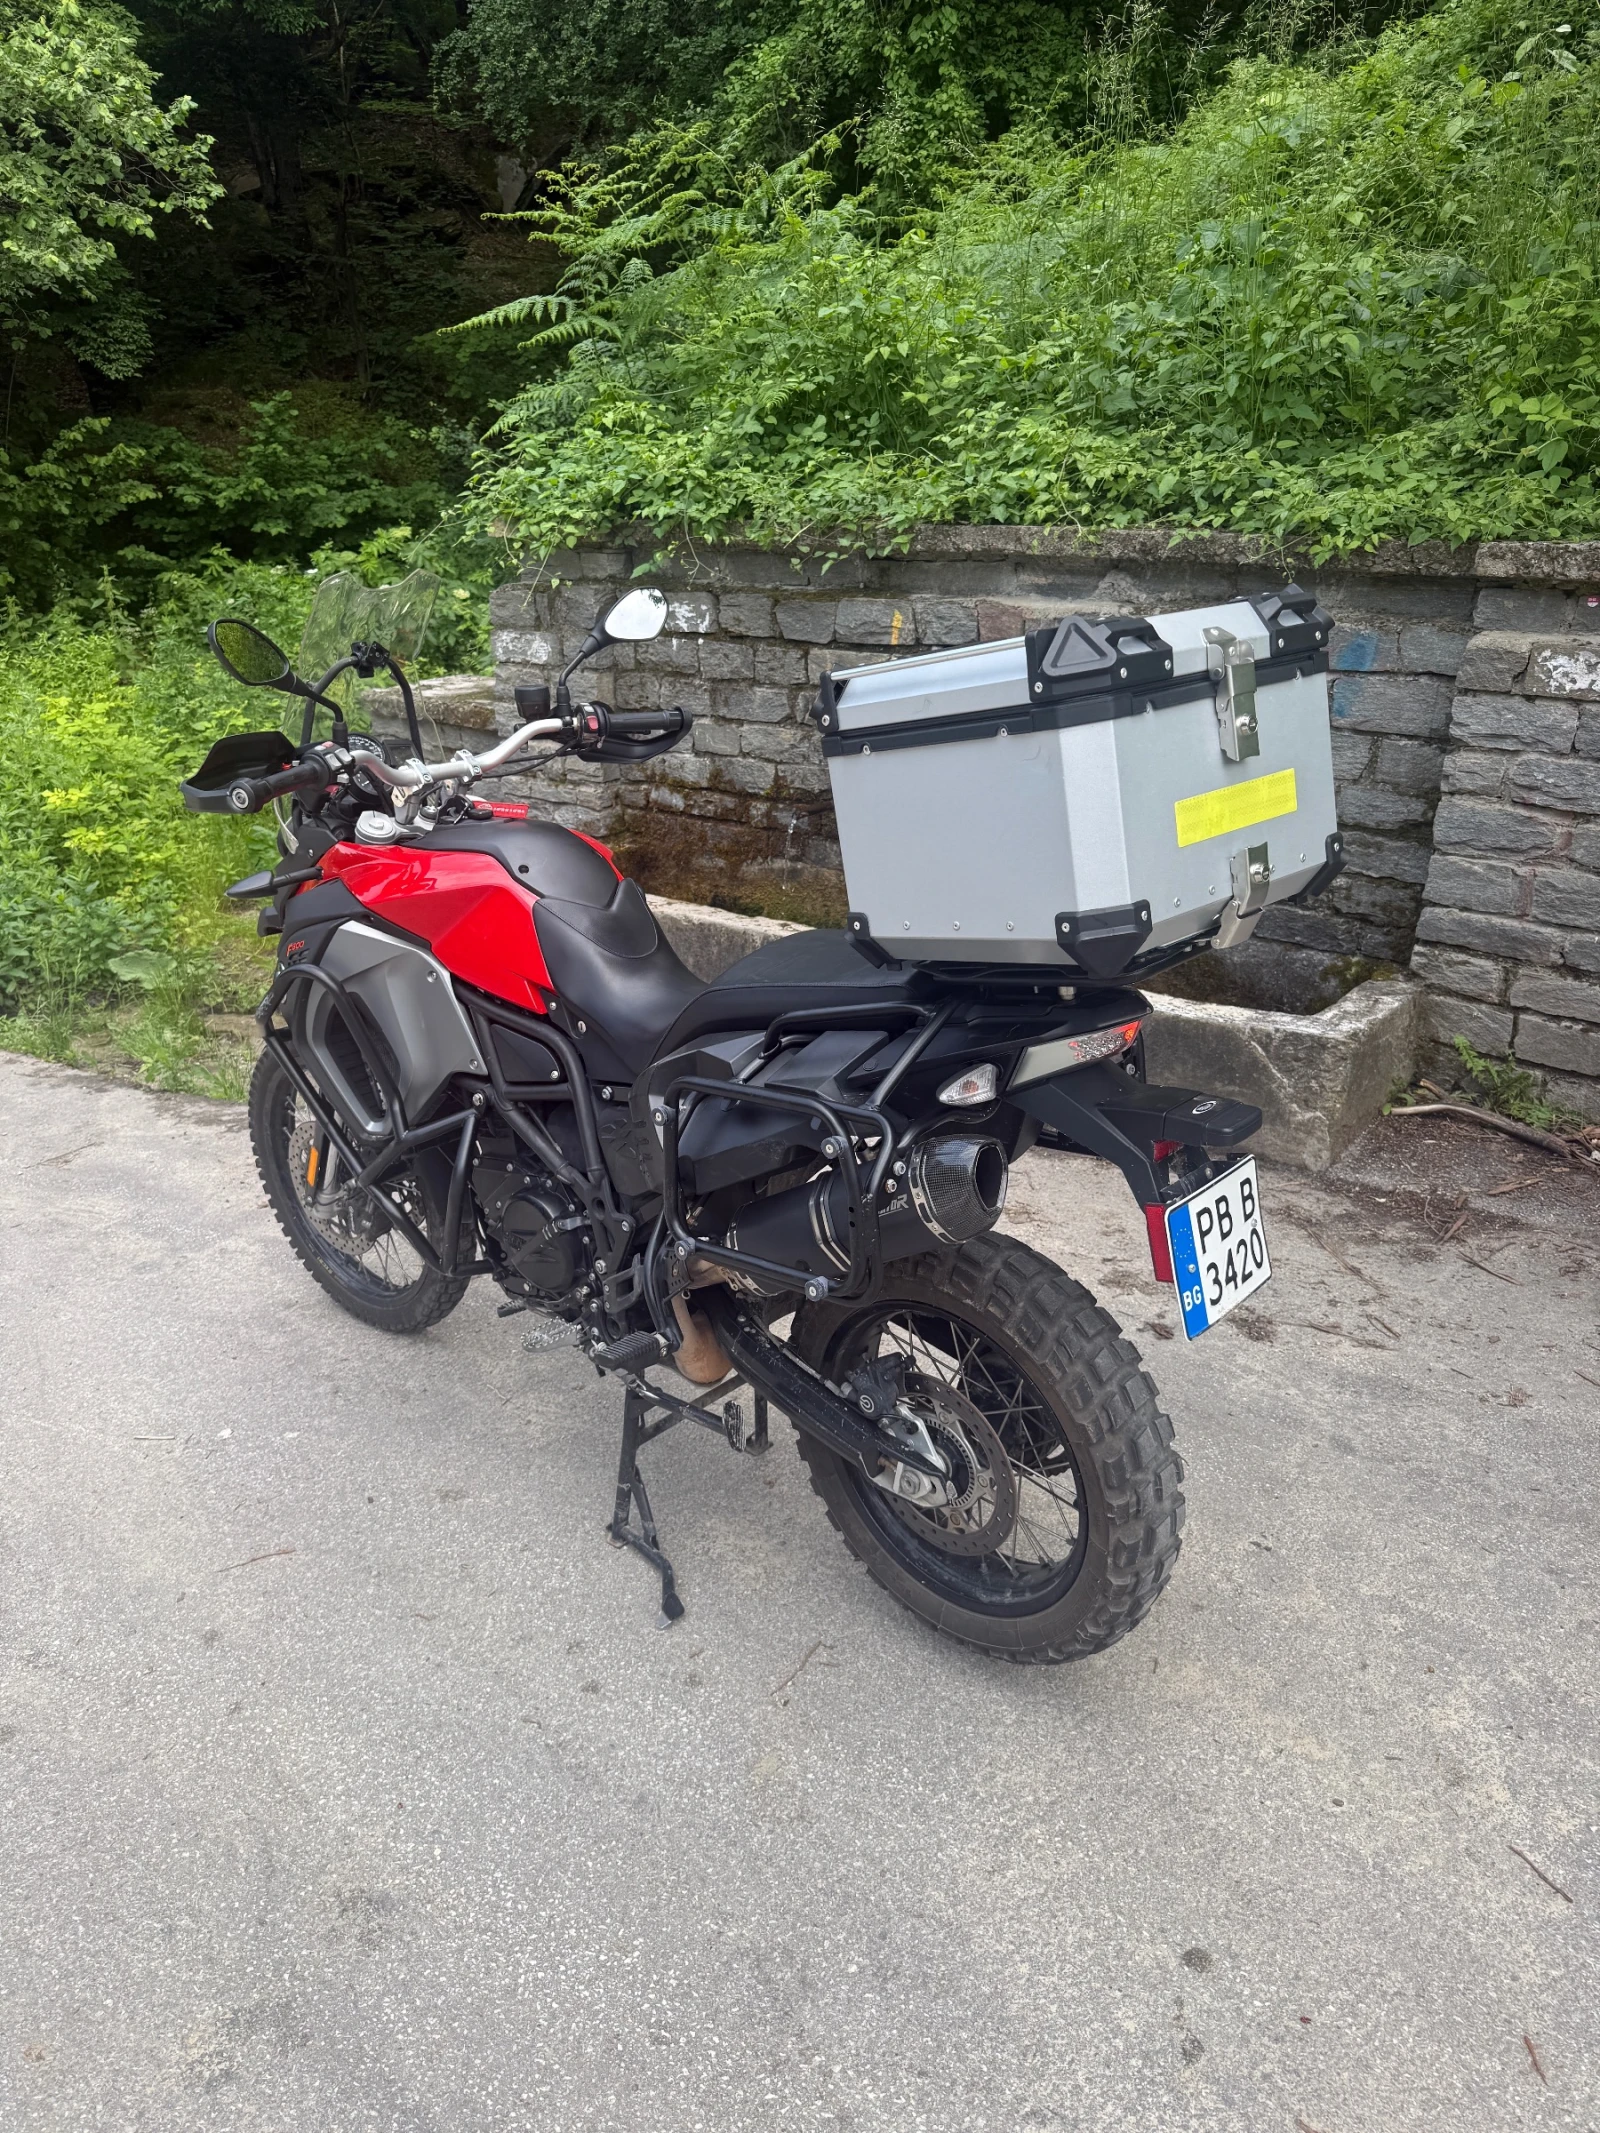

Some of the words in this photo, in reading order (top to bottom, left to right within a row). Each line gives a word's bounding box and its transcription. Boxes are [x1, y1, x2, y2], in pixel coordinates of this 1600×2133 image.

[1196, 1195, 1233, 1255] PB
[1240, 1177, 1255, 1223] B
[1182, 1285, 1202, 1312] BG
[1206, 1228, 1264, 1306] 3420
